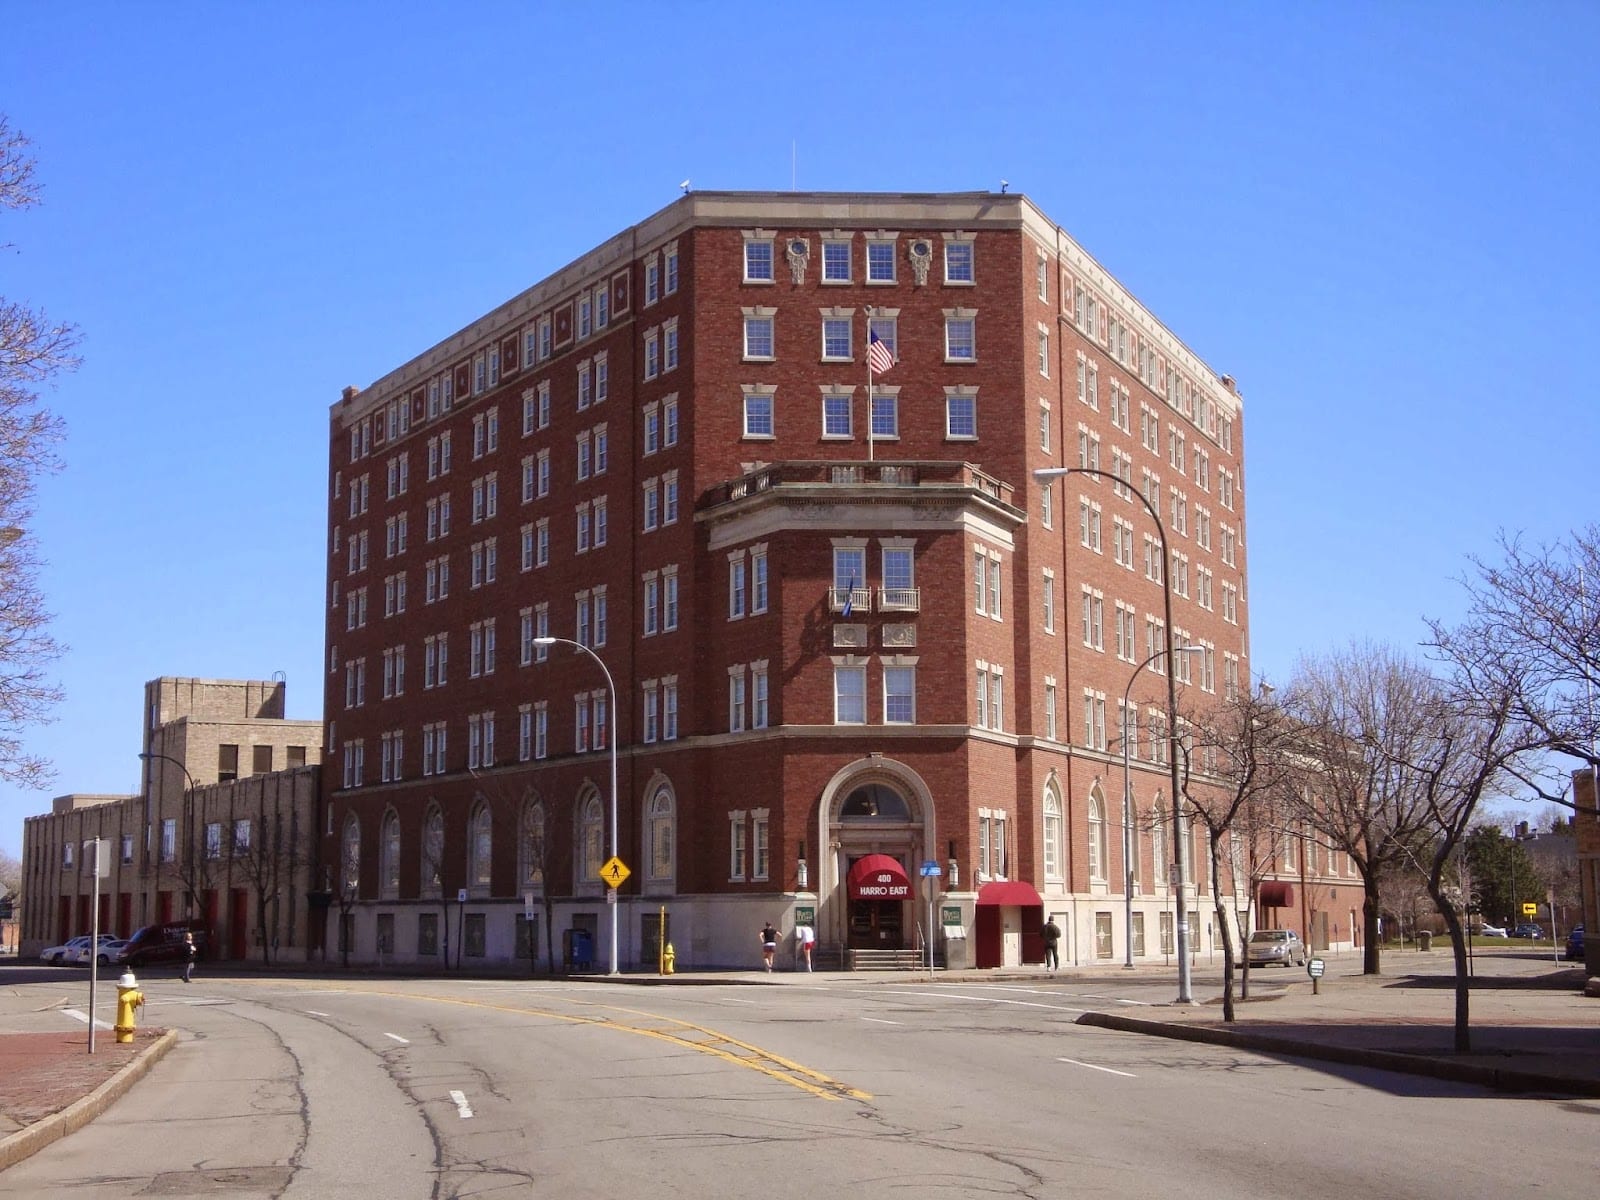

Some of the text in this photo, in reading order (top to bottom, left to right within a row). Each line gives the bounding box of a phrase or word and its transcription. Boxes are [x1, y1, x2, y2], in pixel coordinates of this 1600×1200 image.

[877, 874, 892, 883] 400
[860, 886, 908, 895] HARRO EAST
